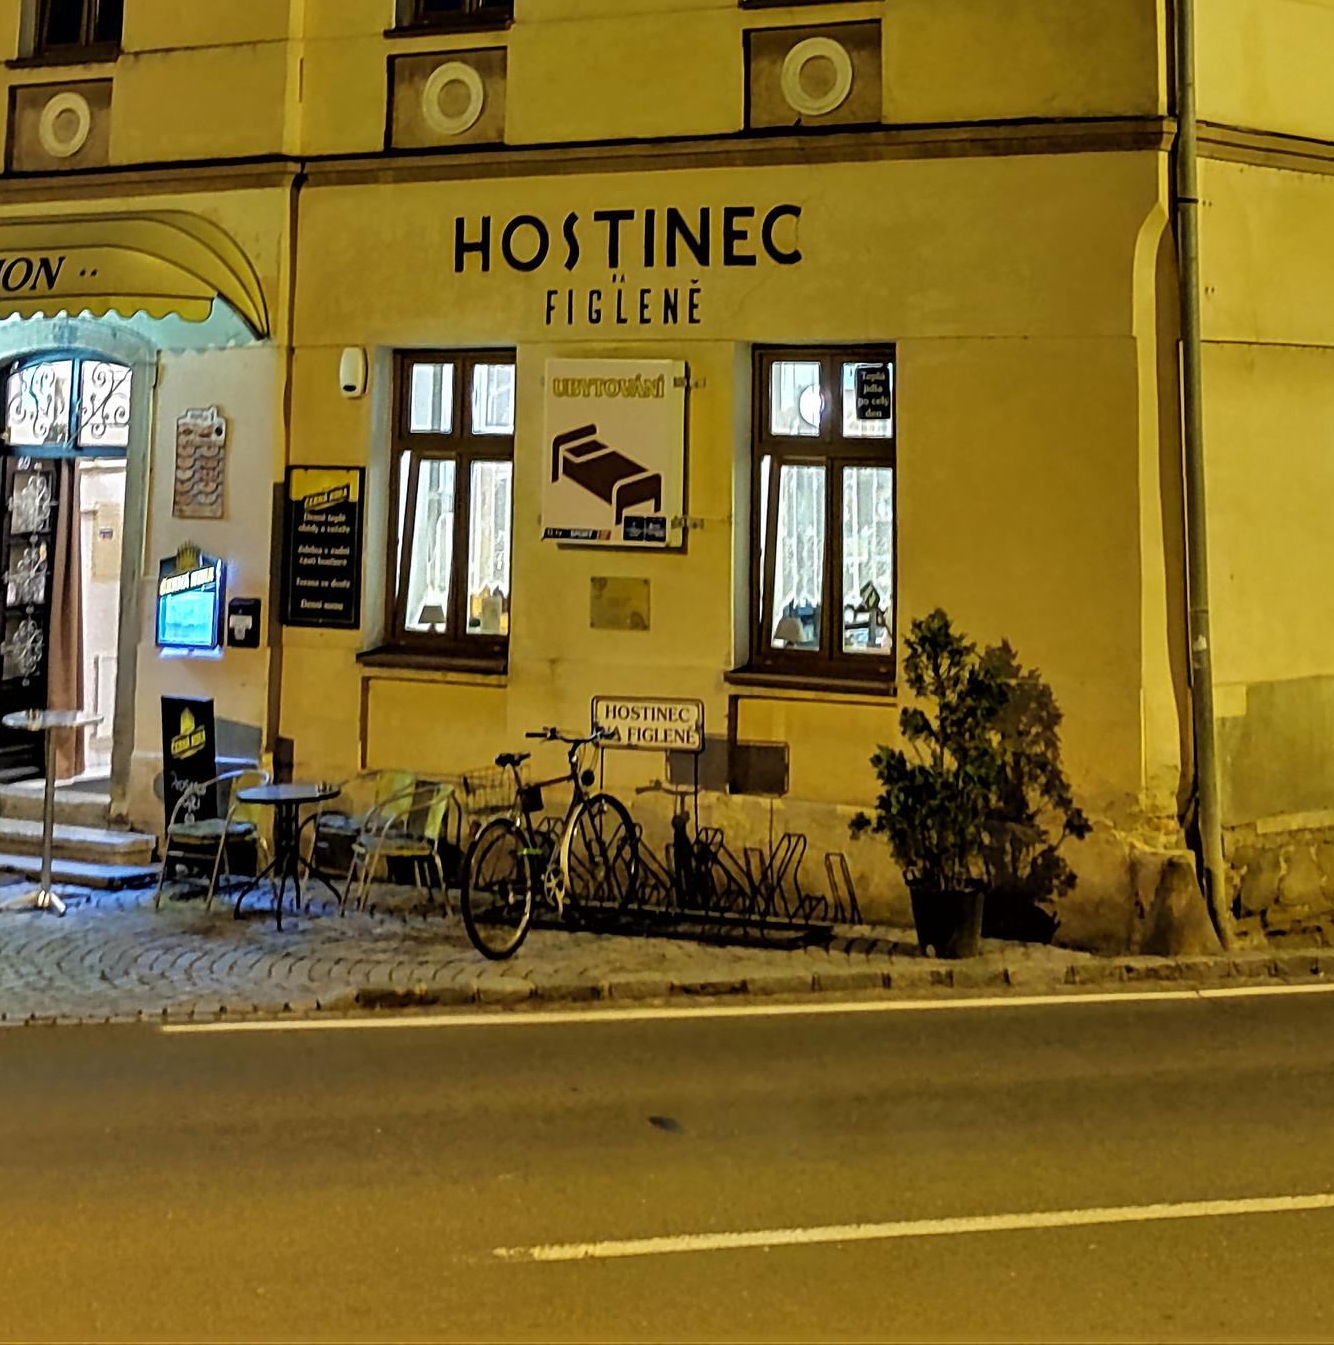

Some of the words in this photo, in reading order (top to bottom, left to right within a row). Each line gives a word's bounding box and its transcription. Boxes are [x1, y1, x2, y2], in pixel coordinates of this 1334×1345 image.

[453, 203, 803, 273] HOSTINEC
[545, 278, 702, 325] FIGLENĚ
[552, 372, 665, 399] UBYTOVÁNÍ
[865, 407, 883, 418] den
[604, 703, 691, 723] HOSTINEC
[627, 724, 696, 745] FIGLENĚ
